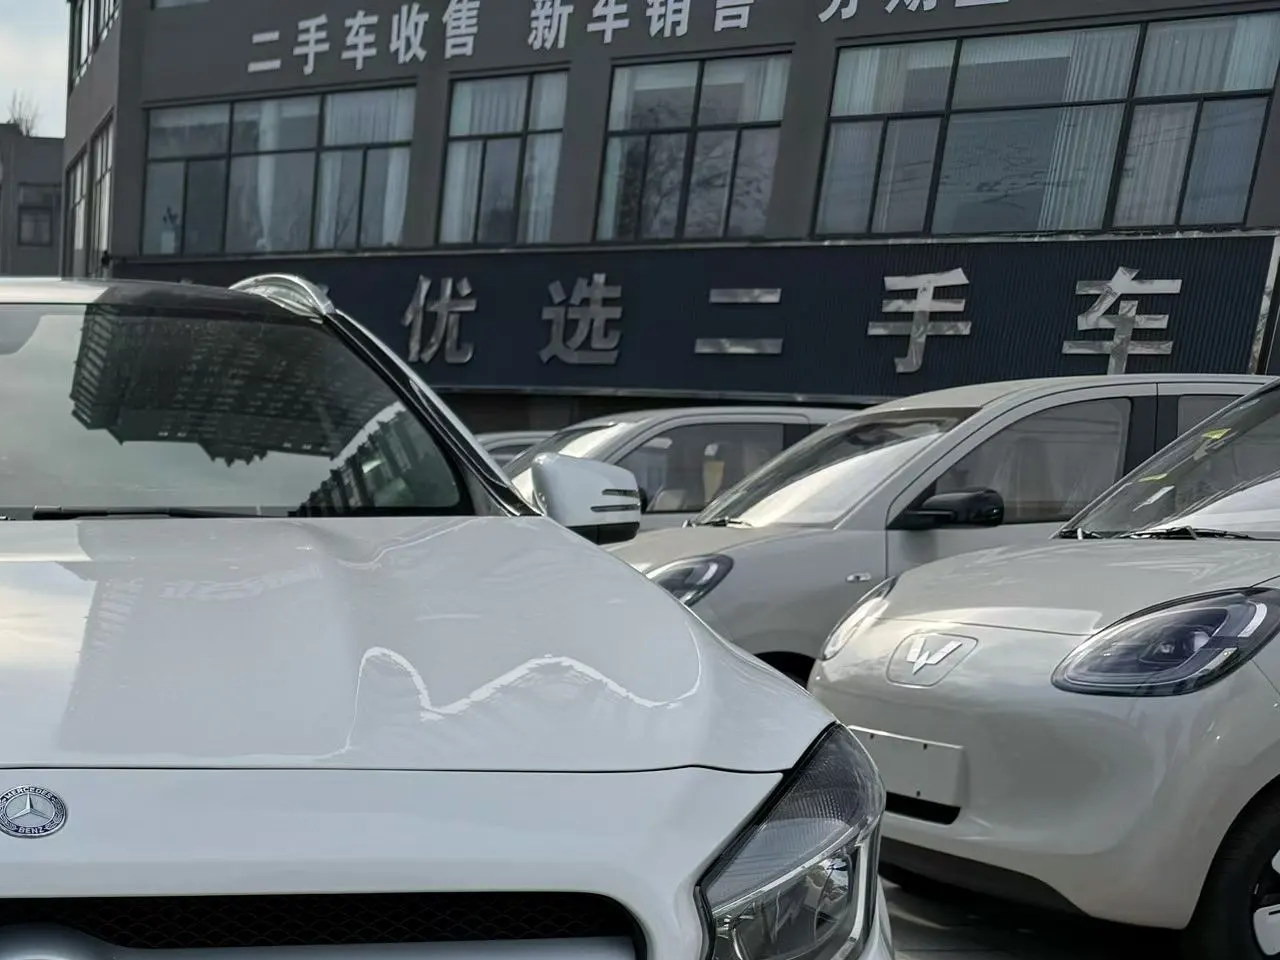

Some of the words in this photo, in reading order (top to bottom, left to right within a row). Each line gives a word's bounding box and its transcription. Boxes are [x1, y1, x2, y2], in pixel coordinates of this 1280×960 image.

[247, 0, 480, 76] 二手车收售
[401, 267, 1182, 375] 优选二手车
